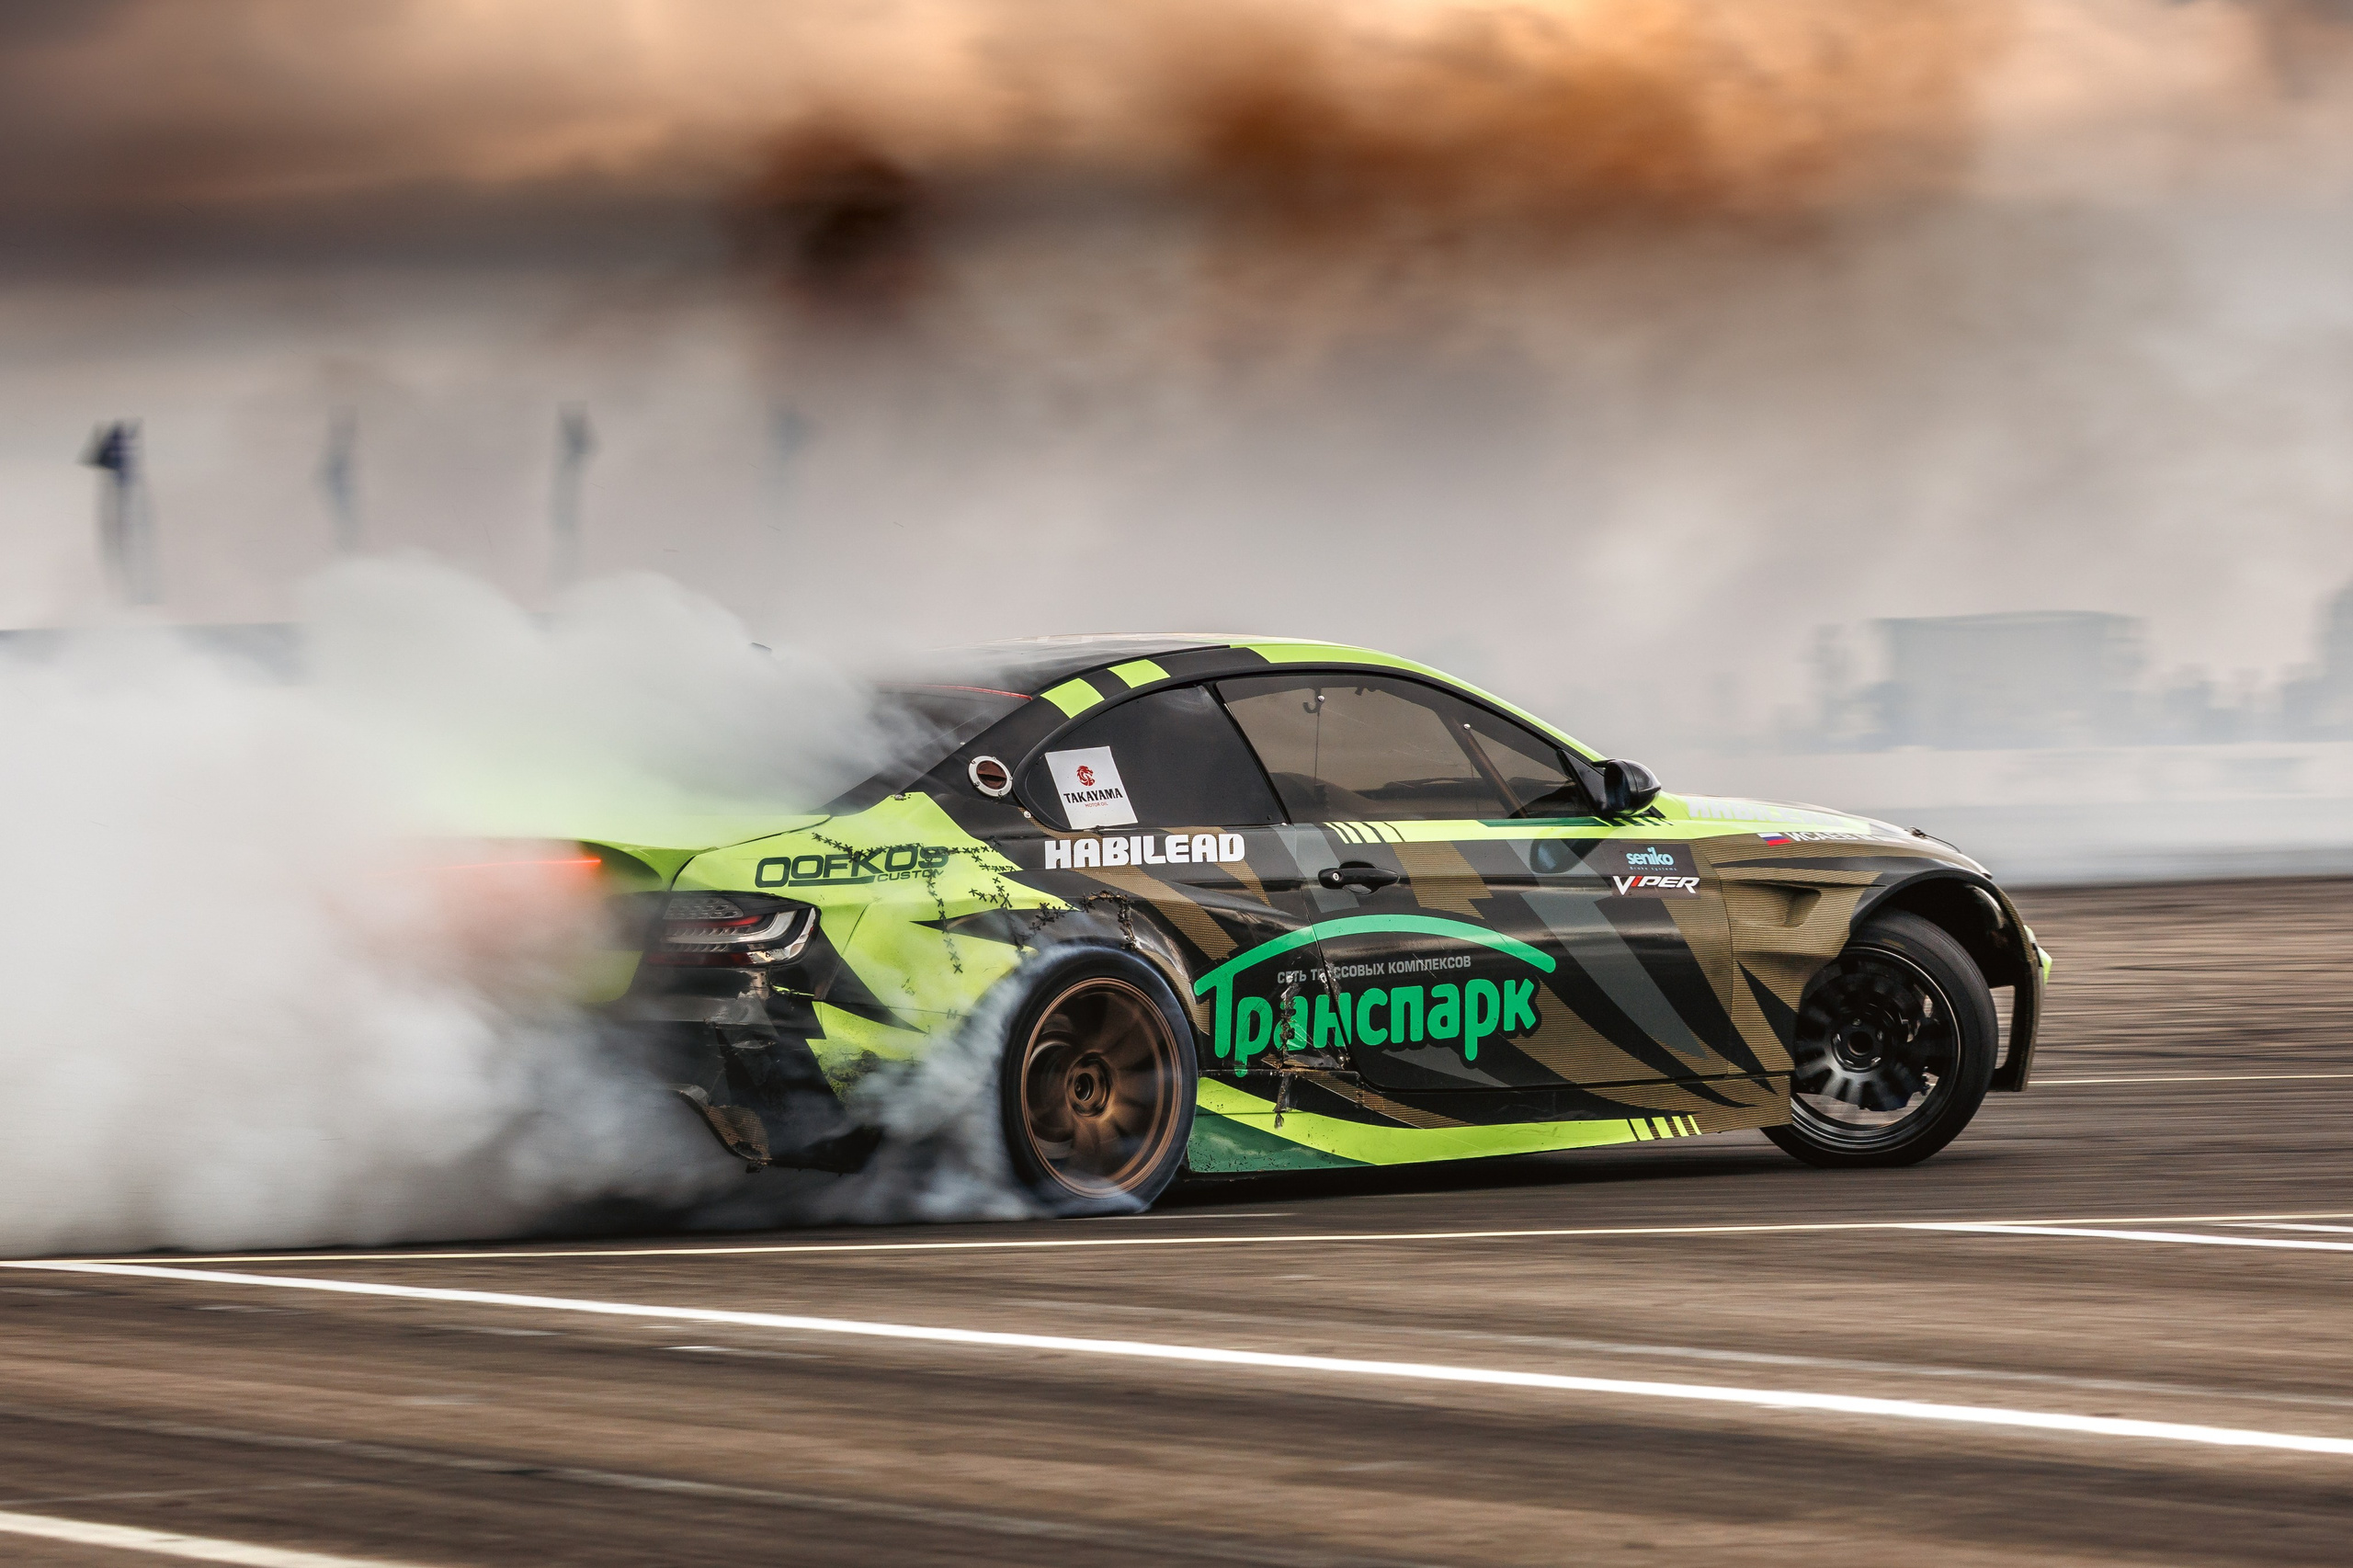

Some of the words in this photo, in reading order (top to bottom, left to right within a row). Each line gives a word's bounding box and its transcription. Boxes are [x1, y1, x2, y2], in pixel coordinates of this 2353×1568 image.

[1063, 788, 1123, 804] TAKAYAMA
[1045, 834, 1245, 869] HABILEAD
[1626, 846, 1675, 865] seniko
[1612, 875, 1700, 896] VIPER
[1311, 962, 1384, 982] ТРССОВЫХ
[1388, 955, 1472, 974] КОМПЛЕКСОВ
